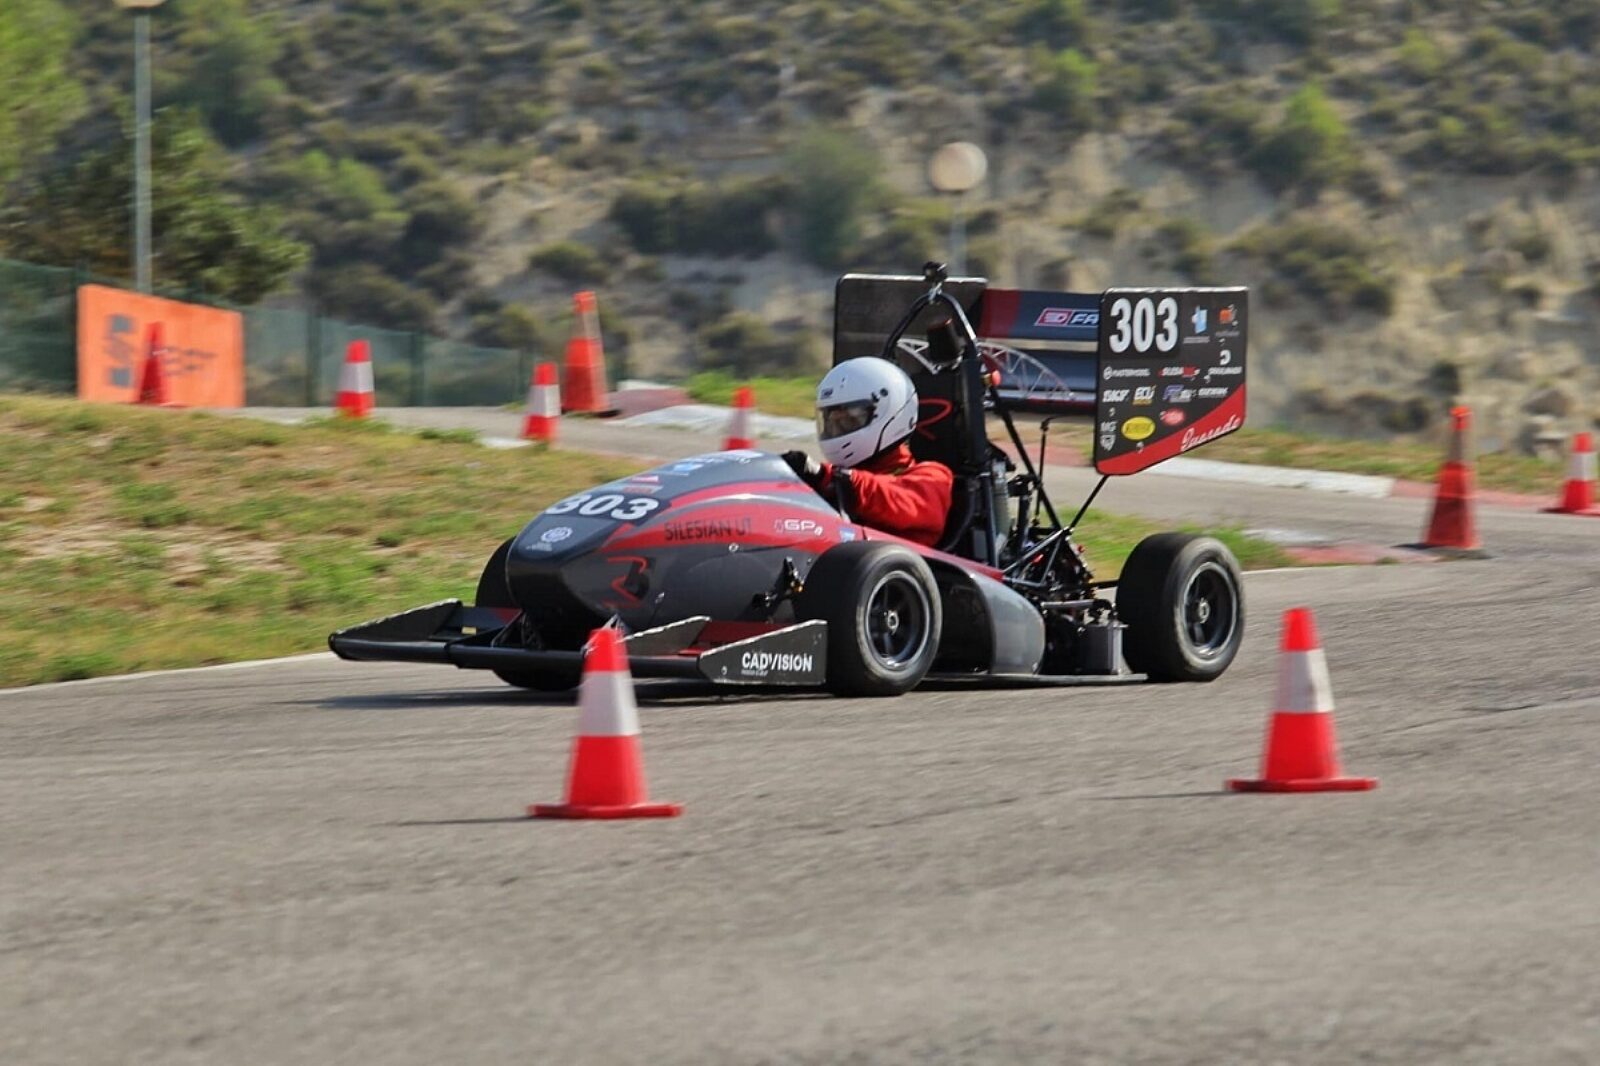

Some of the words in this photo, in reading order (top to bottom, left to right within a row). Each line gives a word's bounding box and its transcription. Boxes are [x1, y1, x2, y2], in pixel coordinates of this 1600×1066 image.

[1109, 297, 1179, 353] 303
[545, 493, 660, 520] 303
[664, 519, 732, 542] SILESIAN
[741, 651, 813, 672] CADVISION
